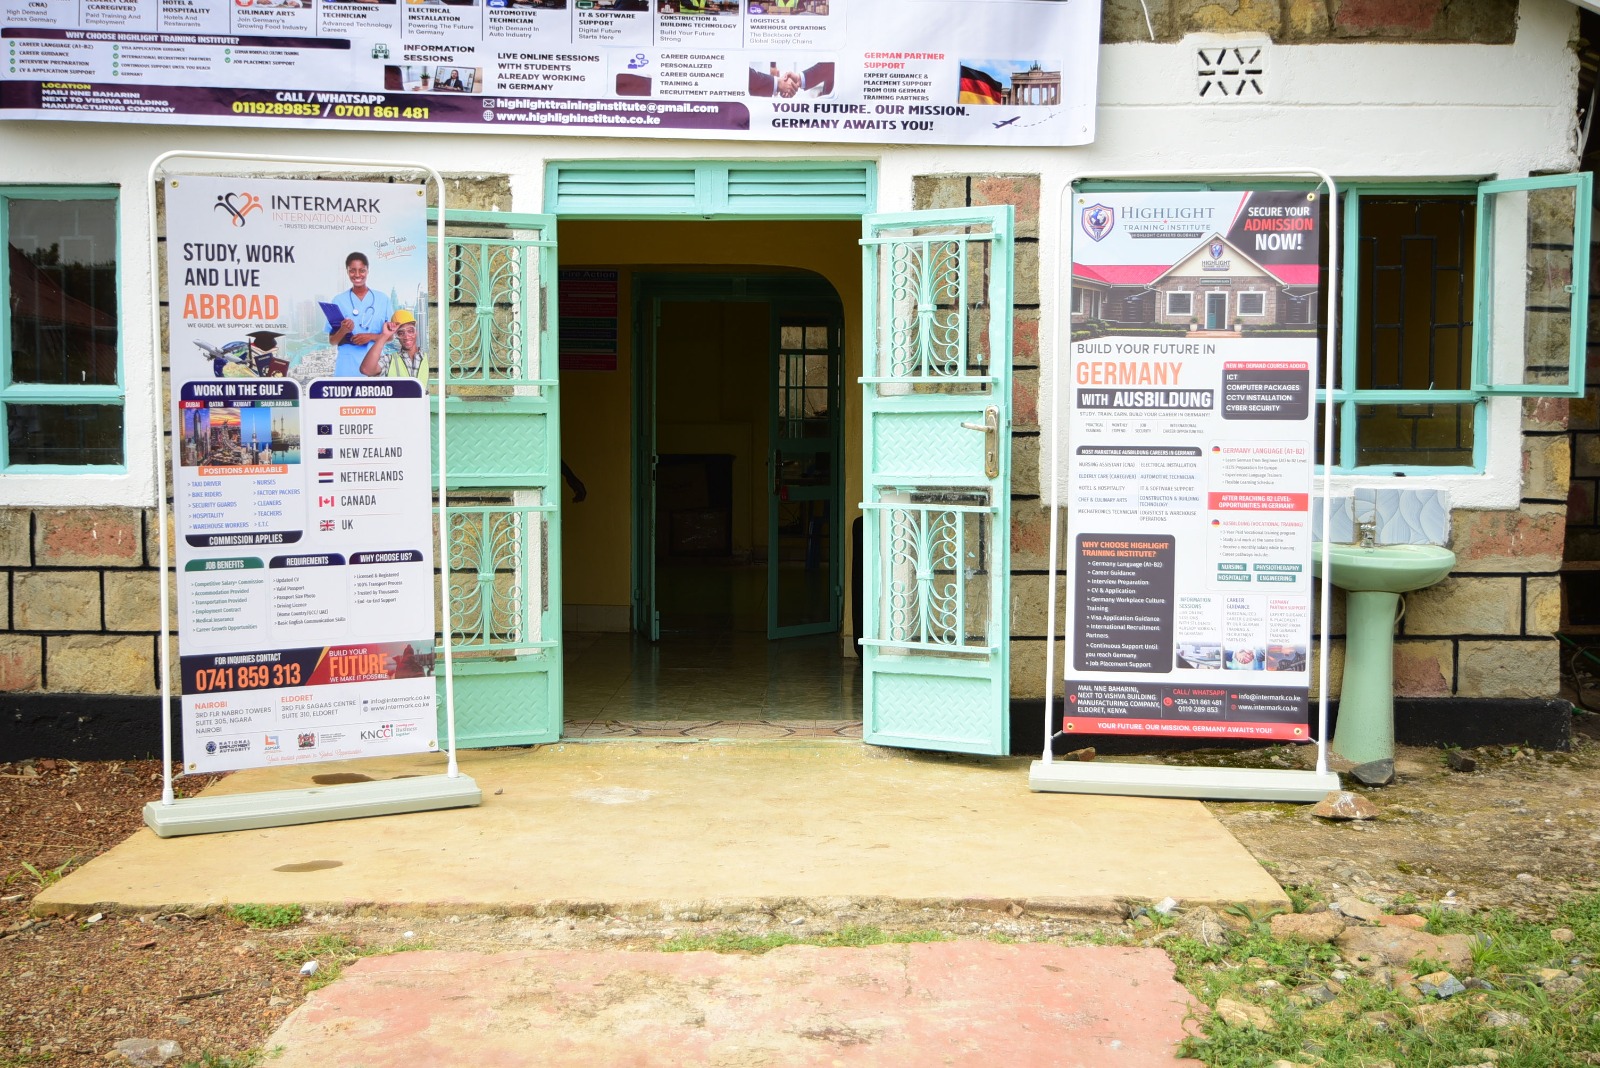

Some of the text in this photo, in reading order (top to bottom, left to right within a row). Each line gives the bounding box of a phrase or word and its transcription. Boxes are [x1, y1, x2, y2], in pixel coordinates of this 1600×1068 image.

[66, 31, 239, 44] WHY CHOOSE HIGHLIGHT TRAINING INSTITUTE?
[404, 44, 474, 52] INFORMATION
[404, 54, 453, 62] SESSIONS
[123, 98, 169, 106] BUILDING
[276, 92, 385, 104] CALL / WHATSAPP
[42, 103, 176, 113] MANUFACTURING COMPANY
[232, 101, 429, 119] 0119289853 / 0701 861 481
[497, 99, 718, 114] highlighttraininginstitute@gmail.com
[772, 103, 969, 116] YOUR FUTURE. OUR MISSION.
[497, 112, 660, 125] www.highlighinstitute.co.ke
[772, 118, 934, 130] GERMANY AWAITS YOU!
[272, 195, 380, 213] INTERMARK
[1248, 207, 1310, 216] SECURE YOUR
[272, 212, 377, 224] INTERNATIONAL LTD
[1244, 218, 1313, 231] ADMISSION
[1255, 233, 1302, 250] NOW!
[183, 243, 295, 264] STUDY, WORK
[184, 268, 261, 287] AND LIVE
[183, 294, 279, 320] ABROAD
[1077, 344, 1215, 354] BUILD YOUR FUTURE IN
[1077, 362, 1183, 385] GERMANY
[194, 384, 284, 396] WORK IN THE GULF
[323, 386, 393, 397] STUDY ABROAD
[1082, 392, 1211, 407] WITH AUSBILDUNG
[339, 424, 374, 435] EUROPE
[339, 447, 403, 458] NEW ZEALAND
[340, 470, 403, 483] NETHERLANDS
[341, 495, 376, 506] CANADA
[342, 520, 354, 530] UK
[209, 534, 283, 545] COMMISSION APPLIES
[286, 556, 328, 566] REQUIREMENTS
[360, 552, 412, 563] WHY CHOOSE US?
[205, 560, 244, 570] JOB BENEFITS
[215, 653, 281, 665] FOR INQUIRIES CONTACT
[330, 653, 388, 677] FUTURE
[196, 662, 301, 692] 0741 859 313
[281, 694, 314, 702] ELDORET
[1239, 693, 1301, 702] info@intermark.co.ke
[195, 701, 227, 709] NAIROBI
[1161, 724, 1191, 732] MISSION.
[1192, 725, 1225, 733] GERMANY
